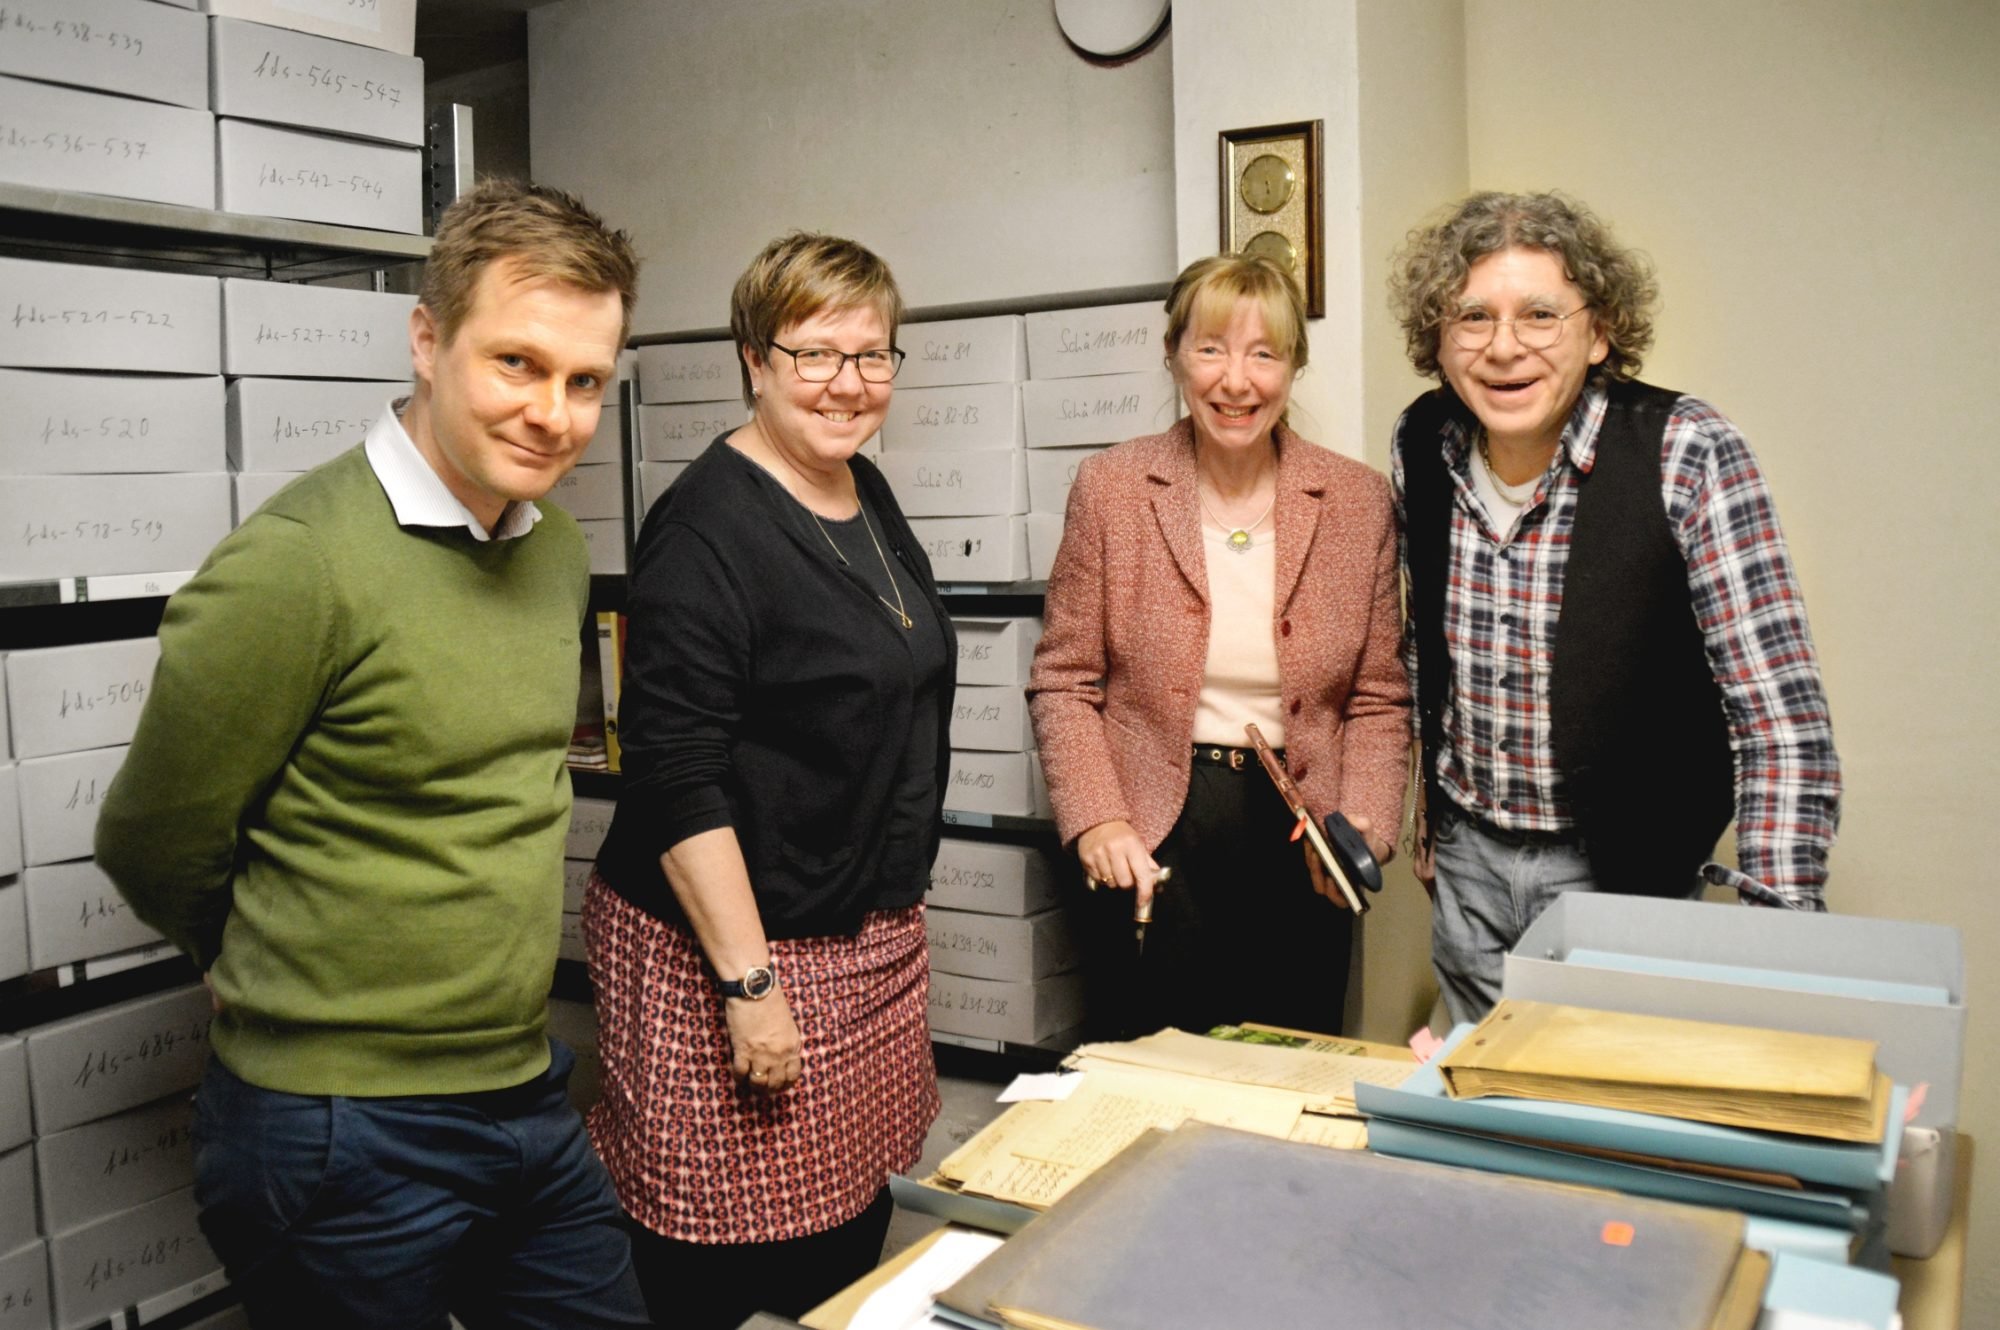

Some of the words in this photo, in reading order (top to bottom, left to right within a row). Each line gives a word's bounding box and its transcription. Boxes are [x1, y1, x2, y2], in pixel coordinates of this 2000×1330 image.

[254, 51, 401, 108] fds-545-547
[0, 125, 150, 160] ds-536-537
[273, 416, 380, 443] fds-525-5
